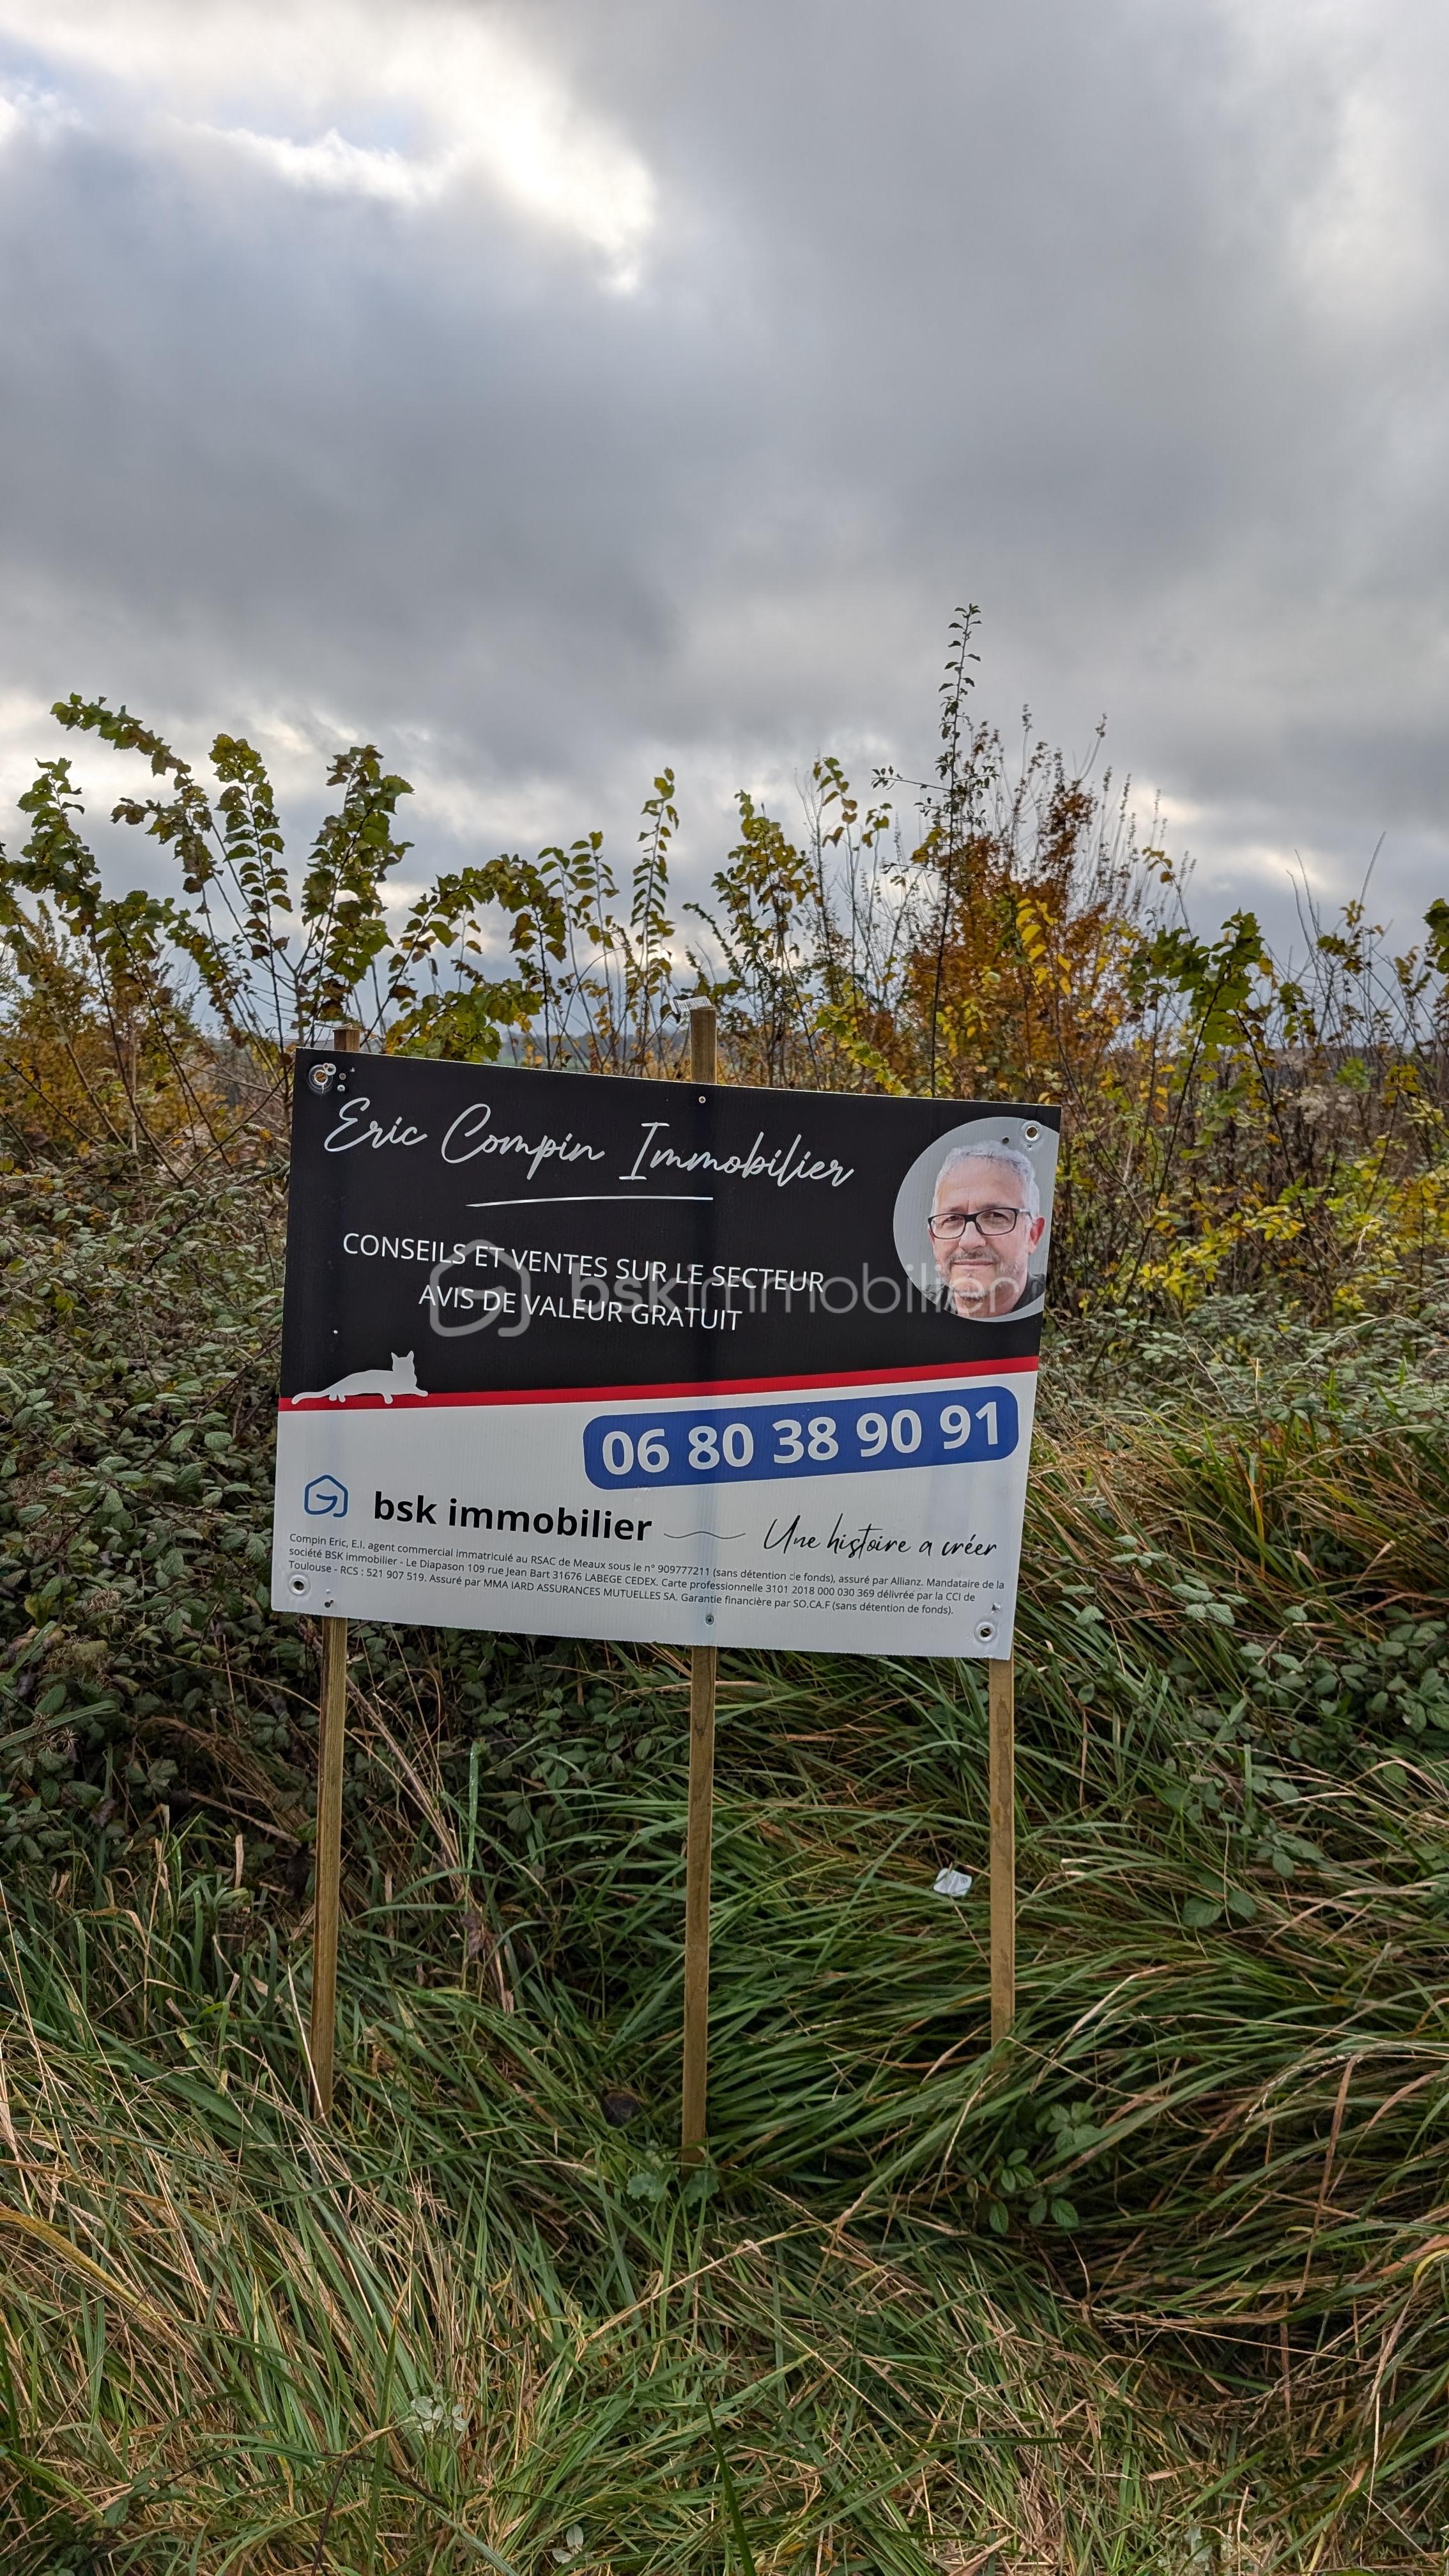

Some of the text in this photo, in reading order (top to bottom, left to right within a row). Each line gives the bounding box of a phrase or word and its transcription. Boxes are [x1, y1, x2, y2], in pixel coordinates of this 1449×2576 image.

[324, 1098, 854, 1186] Eric Compin Immobilier
[343, 1233, 824, 1292] CONSEILS ET VENTES SUR LE SECTEUR
[418, 1284, 742, 1330] AVIS DE VALEUR GRATUIT
[602, 1401, 998, 1475] 06 80 38 90 91
[374, 1491, 652, 1541] bsk immobilier
[763, 1515, 821, 1554] Une
[827, 1513, 912, 1559] histoire
[941, 1534, 997, 1556] créer
[289, 1533, 326, 1545] Compin
[329, 1537, 349, 1548] Eric,
[351, 1540, 365, 1549] E.I.
[368, 1542, 395, 1552] agent
[397, 1545, 453, 1557] commercial
[456, 1549, 513, 1562] immatriculé
[531, 1556, 556, 1566] RSAC
[558, 1558, 571, 1567] de
[574, 1559, 606, 1569] Meaux
[633, 1563, 642, 1572] le
[658, 1565, 709, 1576] 909777211
[713, 1568, 738, 1578] (sans
[740, 1569, 786, 1580] détention
[804, 1573, 836, 1584] fonds),
[838, 1575, 870, 1584] assuré
[873, 1577, 888, 1586] par
[891, 1577, 923, 1586] Allianz.
[926, 1578, 979, 1588] Mandataire
[982, 1581, 993, 1589] de
[997, 1581, 1004, 1589] la
[289, 1547, 322, 1558] société
[325, 1551, 344, 1560] BSK
[346, 1552, 397, 1565] immobilier
[406, 1558, 417, 1567] Le
[420, 1560, 464, 1572] Diapason
[468, 1563, 485, 1574] 109
[506, 1567, 527, 1577] Jean
[530, 1570, 550, 1579] Bart
[553, 1571, 582, 1581] 31676
[585, 1574, 622, 1584] LABEGE
[625, 1576, 659, 1586] CEDEX.
[662, 1578, 687, 1588] Carte
[690, 1581, 763, 1592] professionnelle
[765, 1584, 788, 1593] 3101
[791, 1586, 815, 1595] 2018
[817, 1587, 834, 1595] 000
[837, 1588, 854, 1597] 030
[857, 1589, 874, 1598] 369
[877, 1590, 914, 1599] délivrée
[917, 1592, 933, 1601] par
[935, 1591, 943, 1600] la
[946, 1592, 961, 1601] CCI
[963, 1593, 975, 1602] de
[289, 1560, 332, 1573] Toulouse
[341, 1566, 358, 1576] RCS
[366, 1568, 383, 1578] 521
[387, 1570, 404, 1580] 907
[407, 1572, 426, 1582] 519.
[429, 1574, 462, 1585] Assuré
[464, 1577, 481, 1588] par
[484, 1579, 509, 1590] MMA
[511, 1580, 534, 1591] IARD
[537, 1583, 601, 1596] ASSURANCES
[603, 1589, 661, 1600] MUTUELLES
[663, 1592, 678, 1602] SA.
[681, 1593, 722, 1604] Garantie
[724, 1595, 772, 1606] financière
[774, 1600, 790, 1609] par
[793, 1600, 830, 1609] SO.CA.F
[832, 1602, 857, 1611] (sans
[859, 1602, 905, 1613] détention
[907, 1604, 919, 1613] de
[922, 1605, 953, 1615] fonds).
